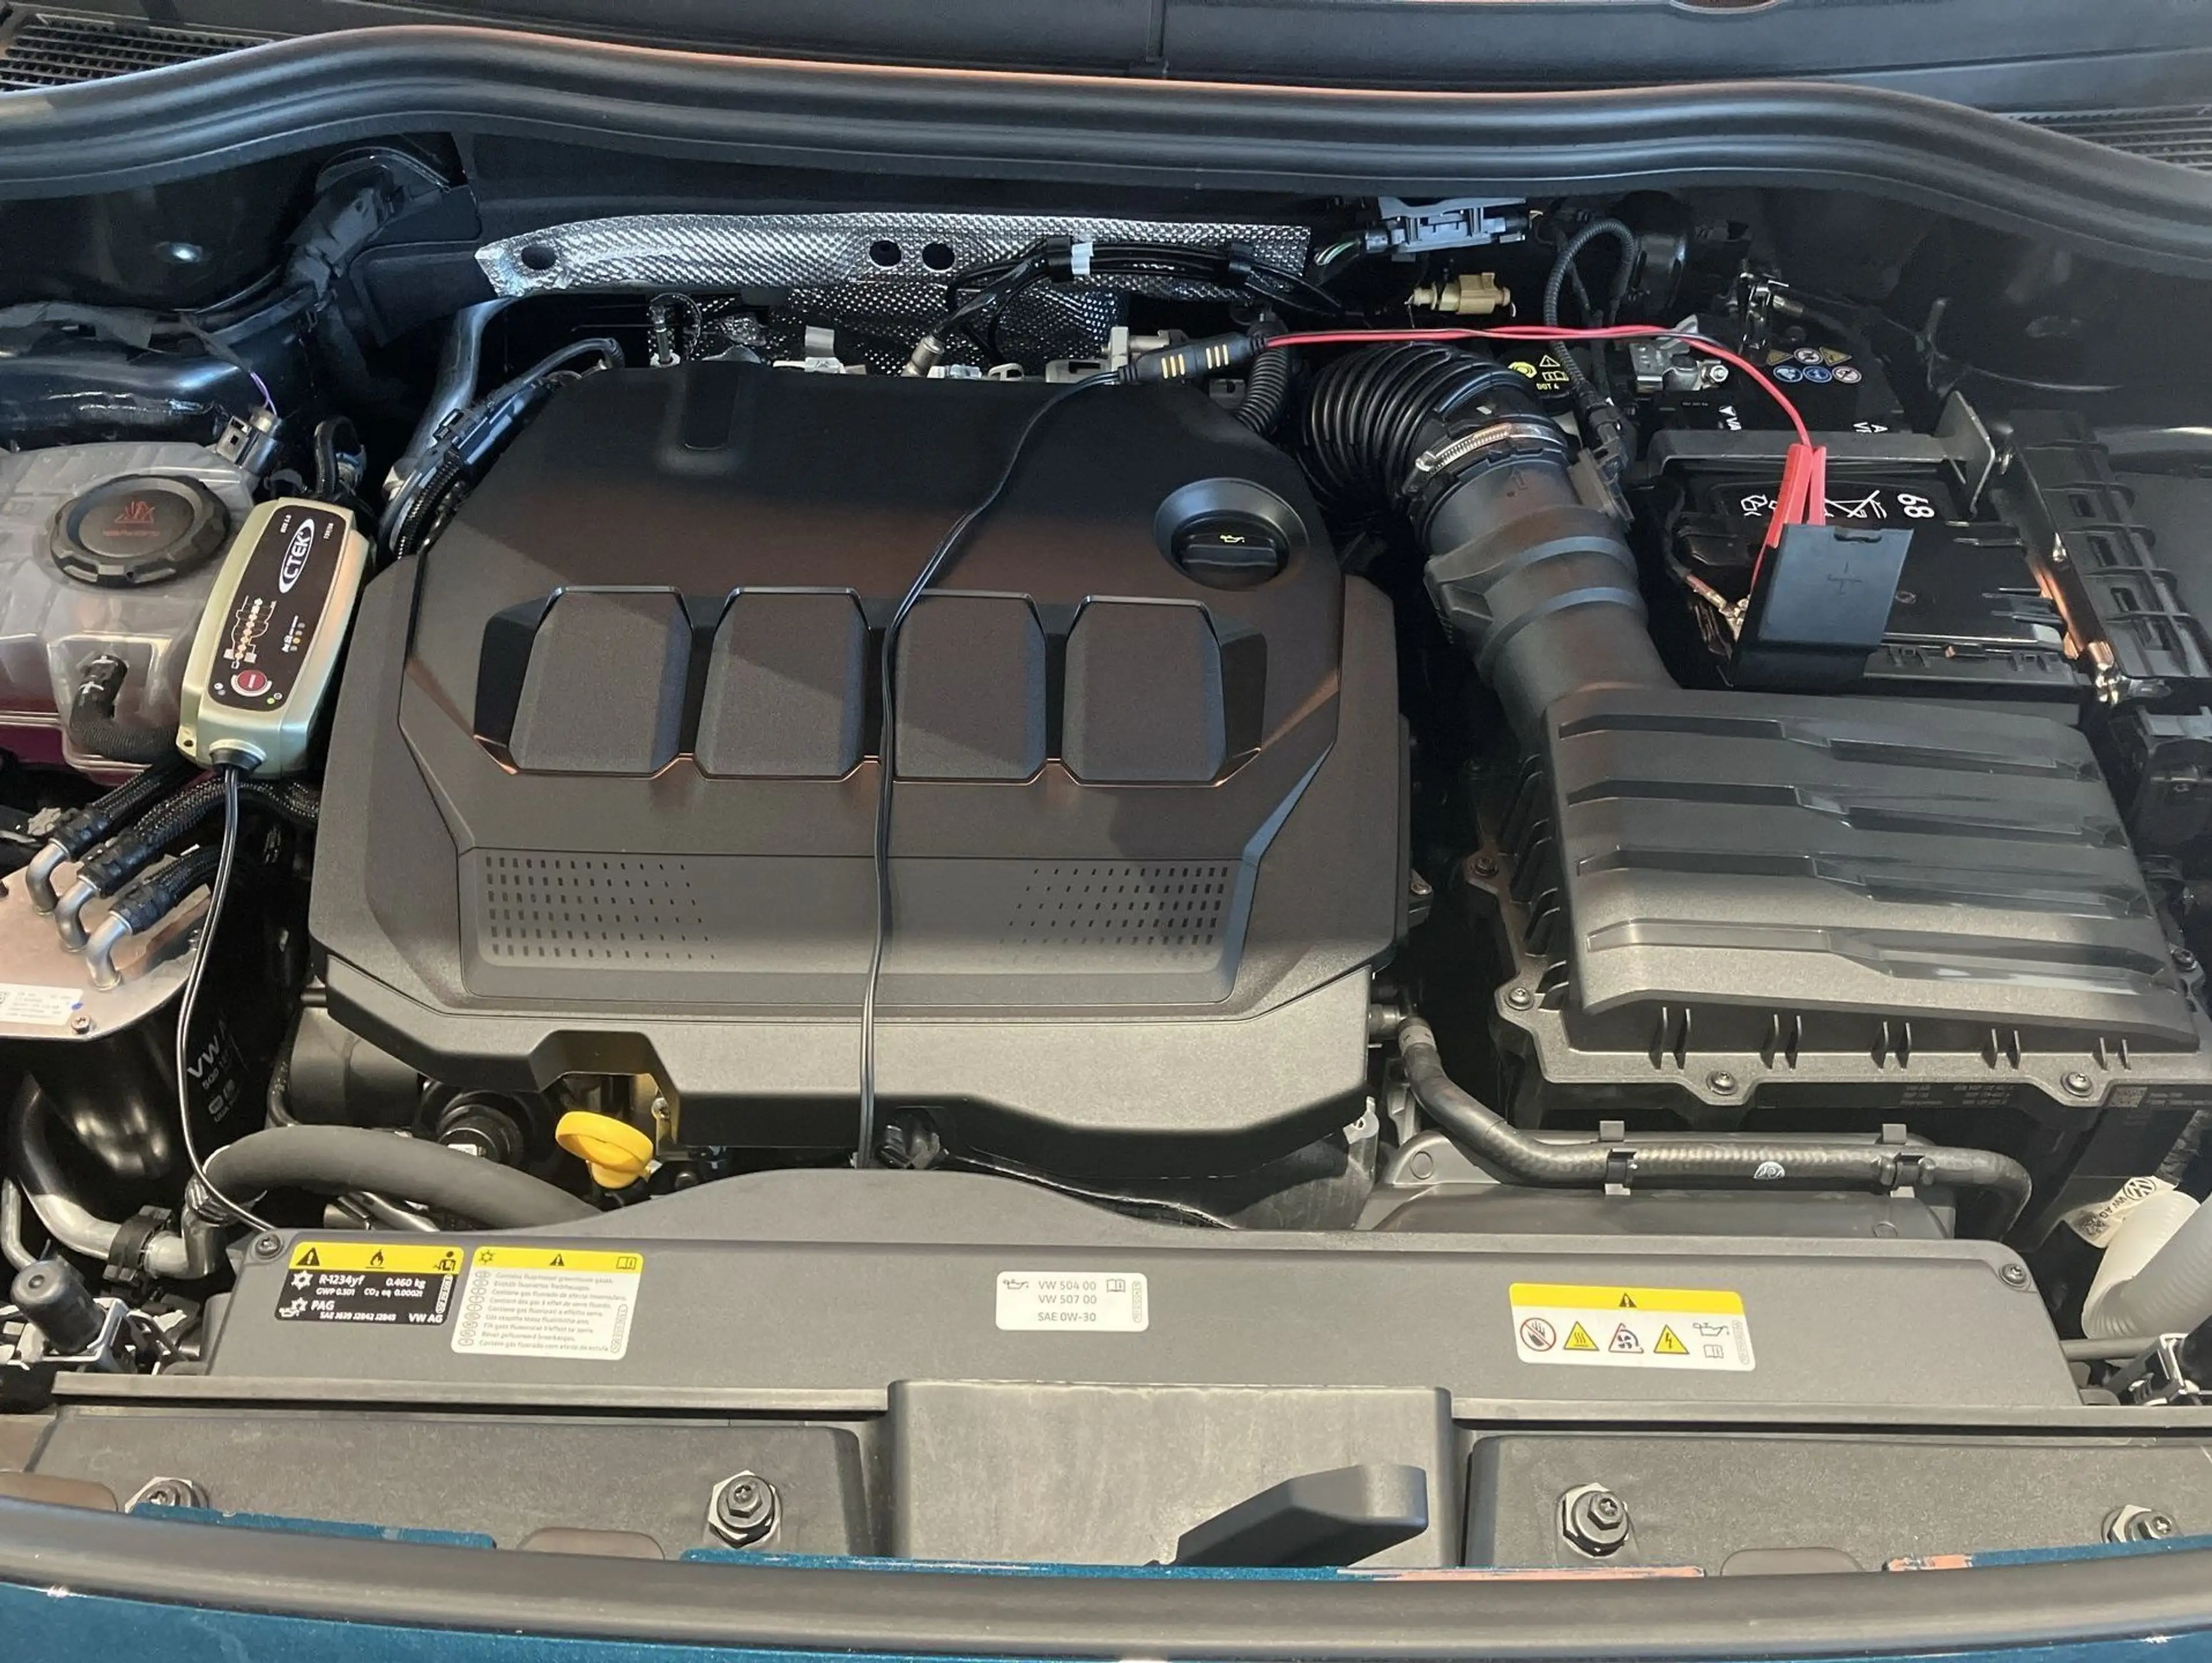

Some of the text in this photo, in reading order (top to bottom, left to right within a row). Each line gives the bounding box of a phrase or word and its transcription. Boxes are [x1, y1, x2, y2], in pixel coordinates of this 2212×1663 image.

[1897, 493, 1935, 519] 68
[284, 532, 311, 579] CTEK
[187, 1034, 219, 1078] VW
[318, 1274, 426, 1289] R-1234yf 0.460 kg
[1038, 1280, 1097, 1291] VW 504 00
[316, 1287, 336, 1296] GWP
[381, 1289, 392, 1298] eq
[1038, 1294, 1097, 1304] VW 507 00
[310, 1300, 335, 1311] PAG
[319, 1311, 335, 1319] SAE
[408, 1312, 444, 1323] VW AG
[1037, 1311, 1097, 1322] SAE 0W-30
